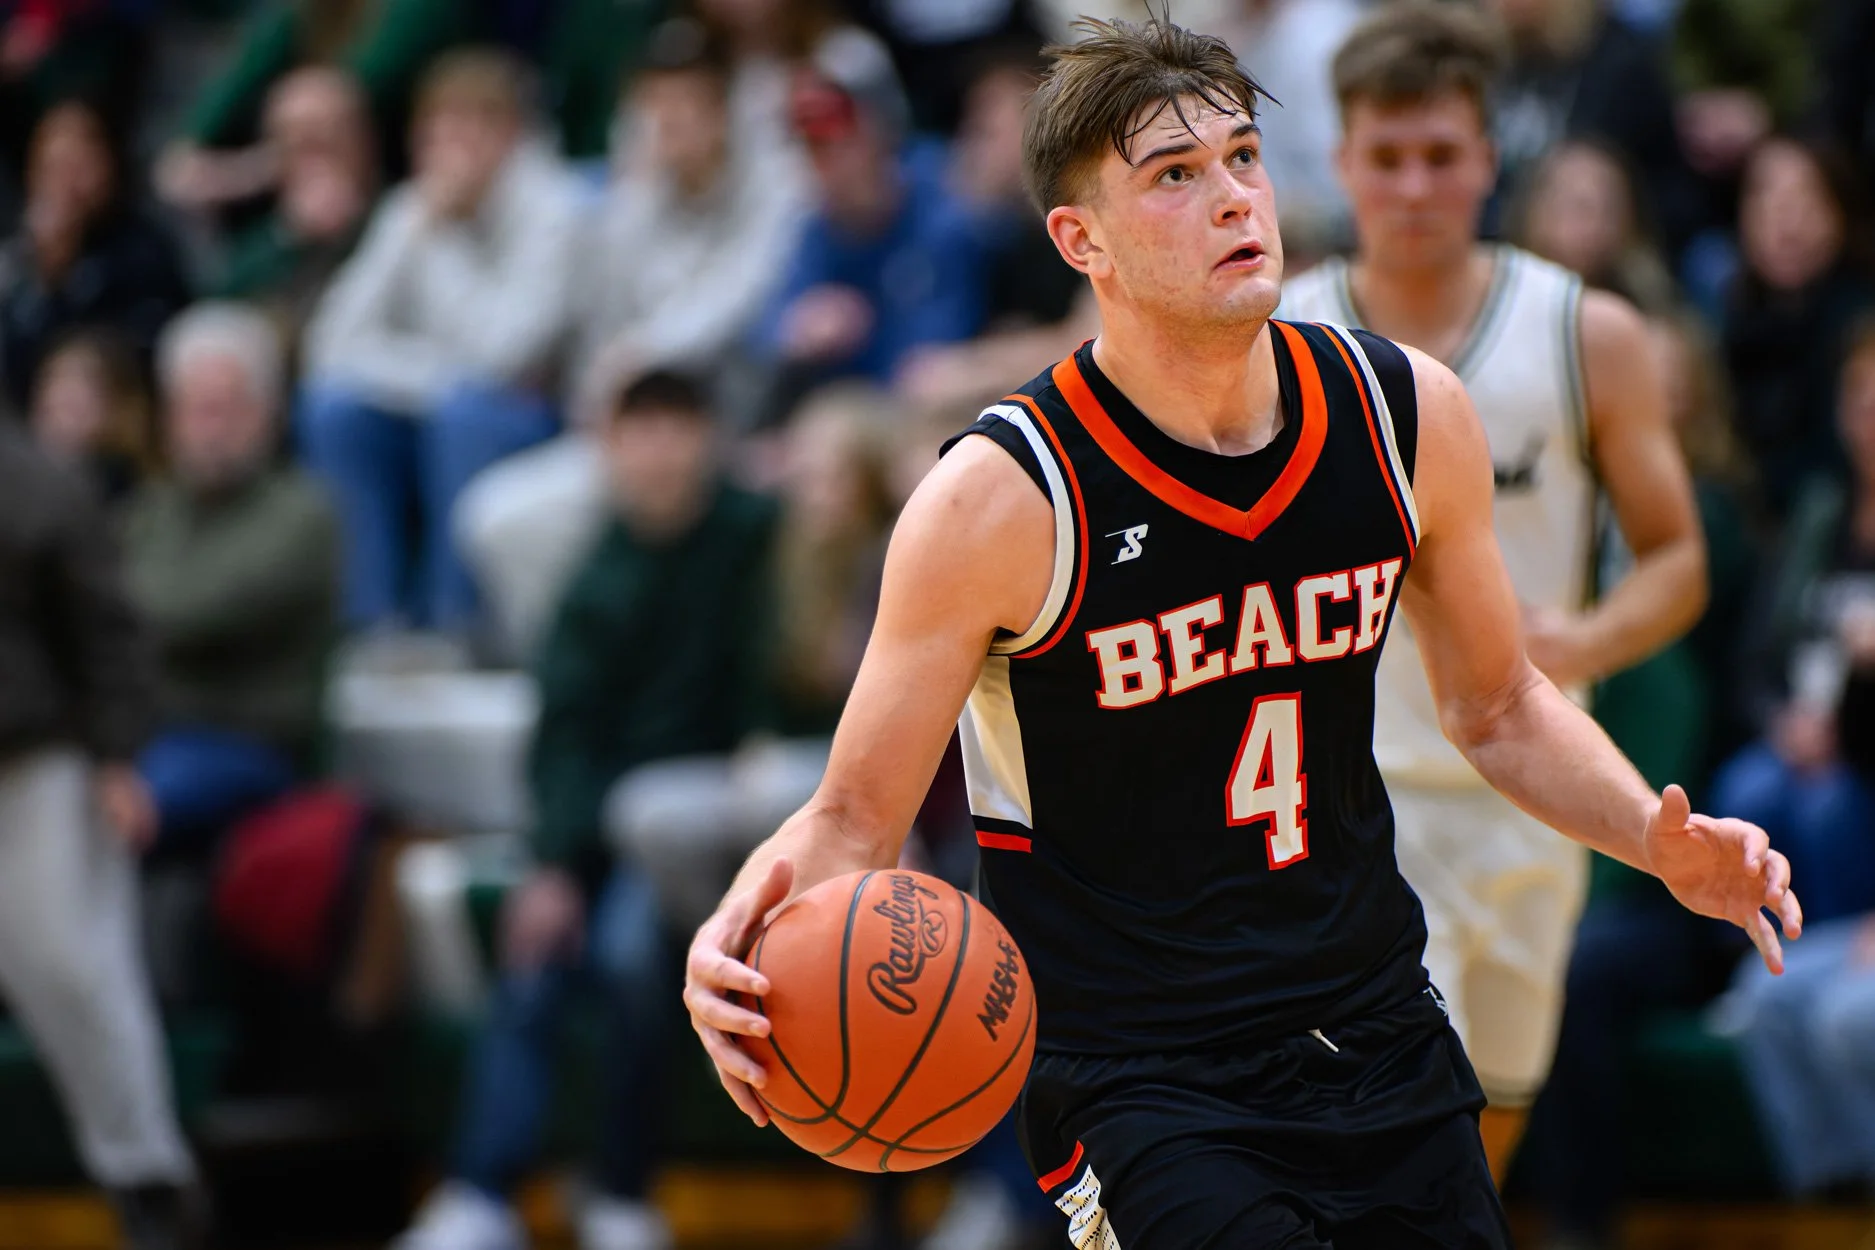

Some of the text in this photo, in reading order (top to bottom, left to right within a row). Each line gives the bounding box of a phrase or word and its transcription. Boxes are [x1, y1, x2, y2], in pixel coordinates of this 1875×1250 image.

[1085, 556, 1402, 710] BEACH
[1225, 691, 1309, 870] 4
[867, 874, 938, 1015] Rawlings
